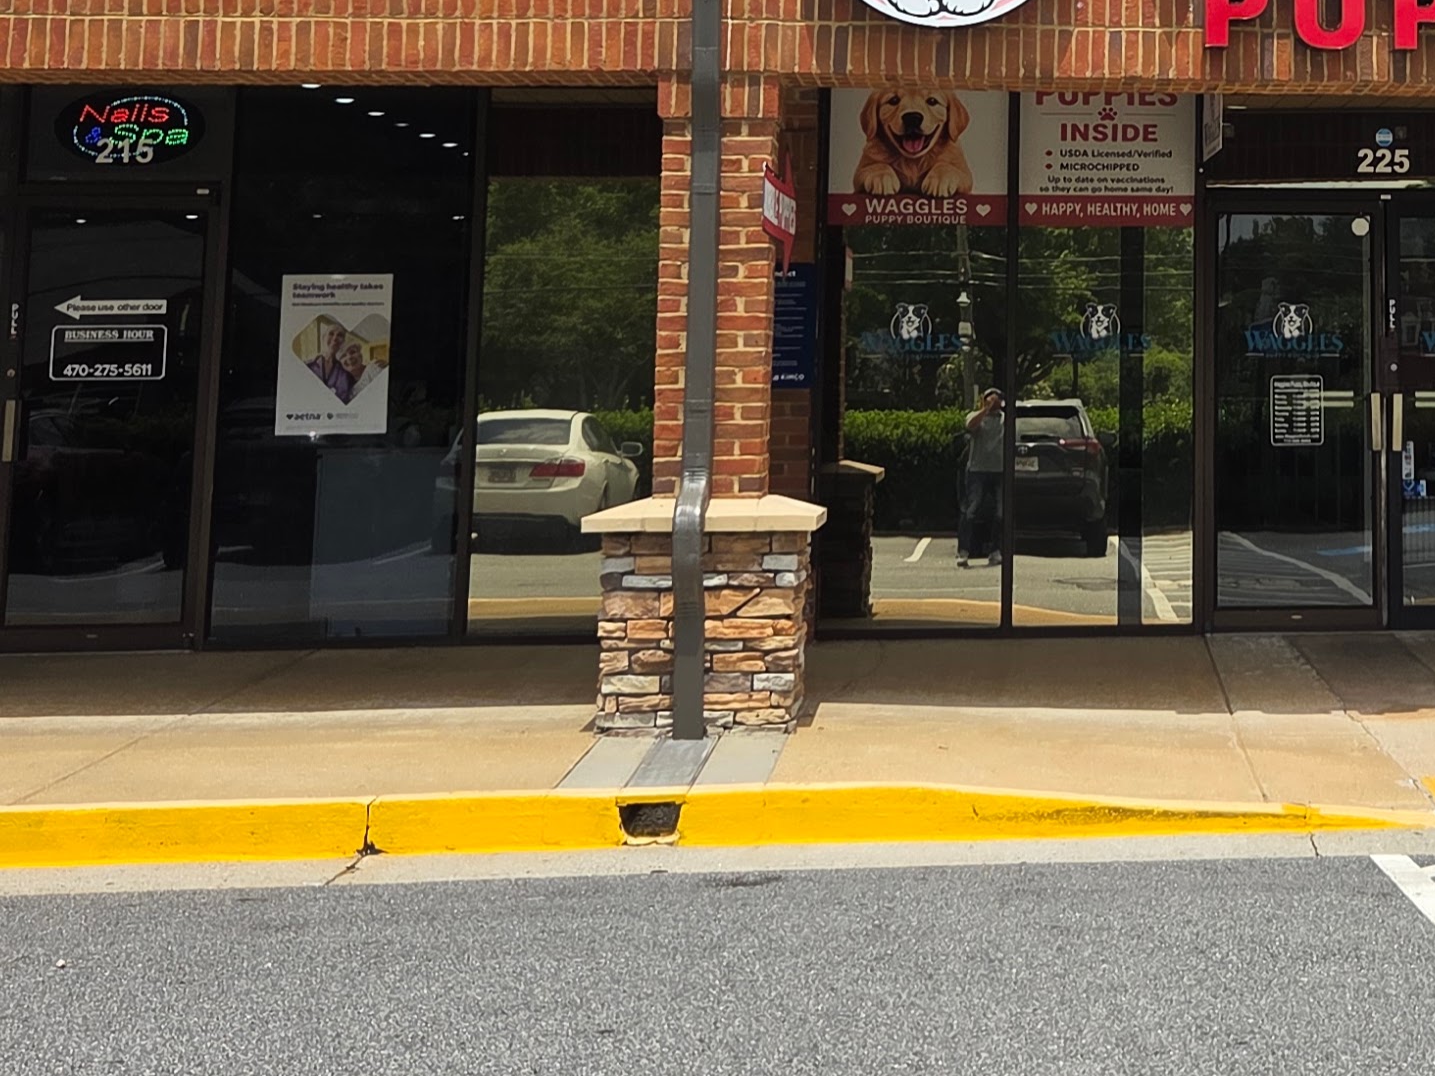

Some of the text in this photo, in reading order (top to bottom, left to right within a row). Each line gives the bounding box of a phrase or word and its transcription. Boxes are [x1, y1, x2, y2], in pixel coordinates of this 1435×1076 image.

[80, 104, 170, 123] Nails
[109, 124, 188, 146] Spa
[1060, 123, 1158, 142] INSIDE
[95, 138, 154, 164] 215
[1059, 149, 1172, 159] USDA Licensed/Verified
[1059, 162, 1140, 171] MICROCHIPPED
[1357, 148, 1410, 173] 225
[1047, 176, 1061, 185] Up
[1063, 176, 1072, 184] to
[1075, 176, 1094, 184] date
[1110, 176, 1165, 184] vaccinations
[1051, 185, 1070, 194] they
[1091, 186, 1101, 194] go
[1104, 185, 1128, 193] home
[1155, 185, 1173, 194] day!
[865, 198, 968, 214] WAGGLES
[1042, 203, 1176, 218] HAPPY, HEALTHY, HOME
[865, 215, 966, 224] PUPPY BOUTIQUE
[66, 303, 96, 312] Please
[117, 303, 141, 311] other
[142, 303, 163, 311] door
[64, 330, 154, 339] BUSINESS HOUR
